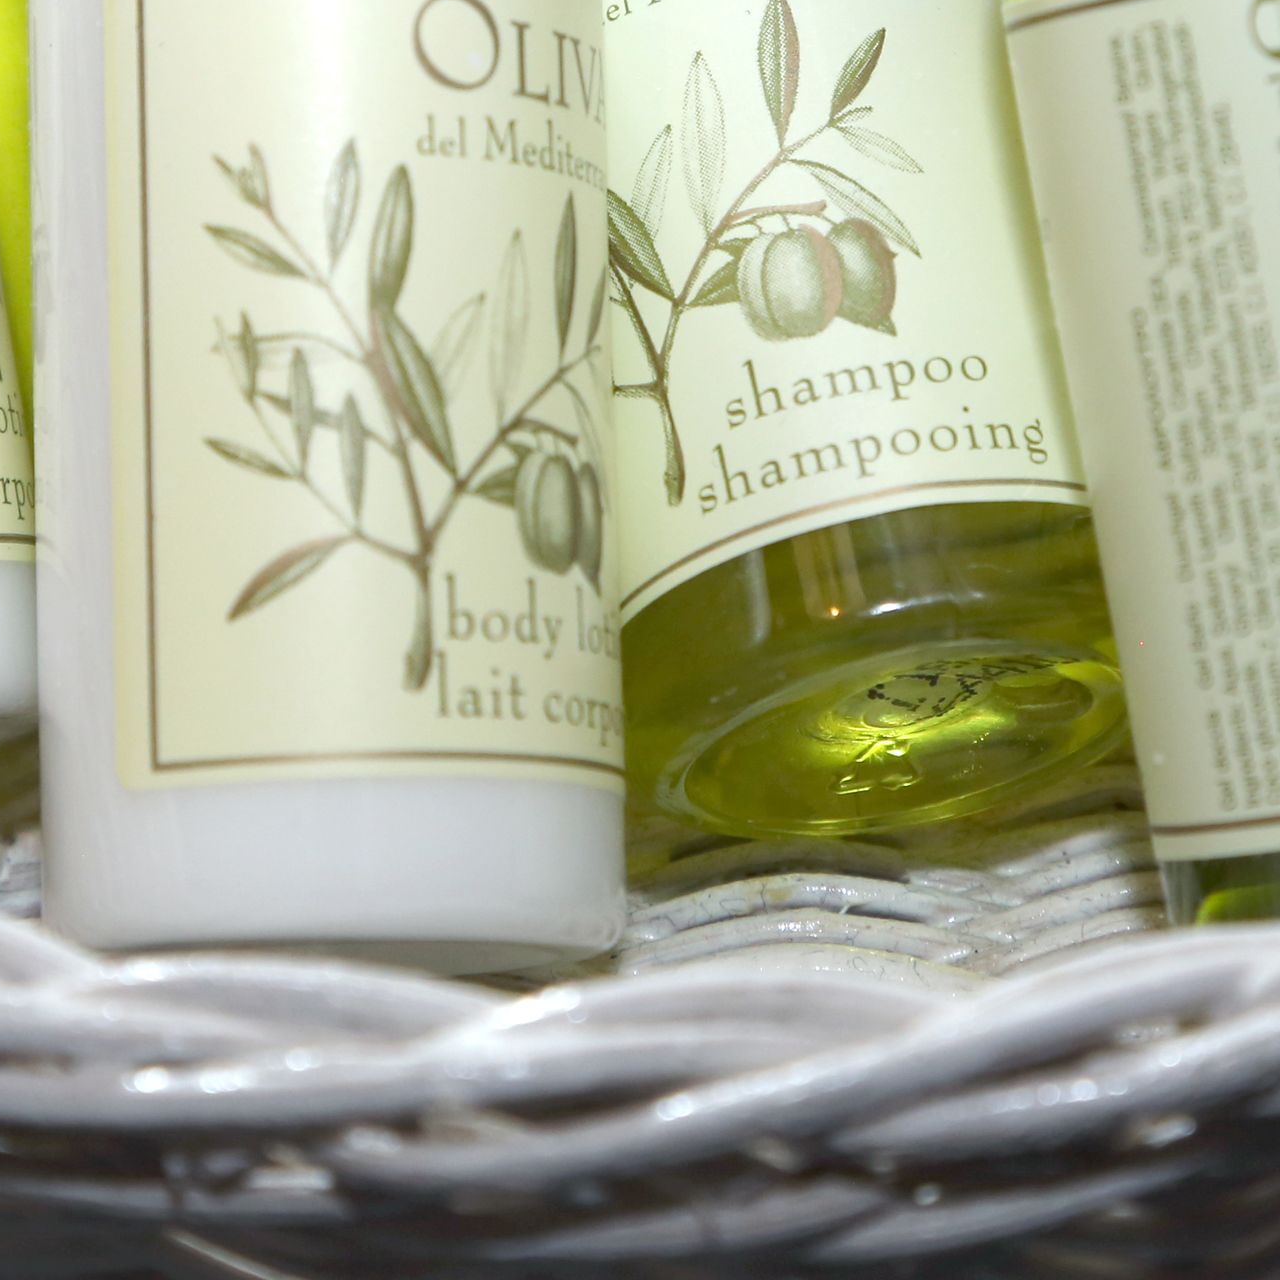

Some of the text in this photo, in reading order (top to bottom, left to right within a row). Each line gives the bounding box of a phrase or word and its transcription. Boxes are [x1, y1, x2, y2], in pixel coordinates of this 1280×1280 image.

[416, 112, 467, 158] del
[725, 355, 989, 430] shampoo
[698, 405, 1048, 514] shampooing
[446, 573, 563, 661] body
[436, 649, 527, 721] lait
